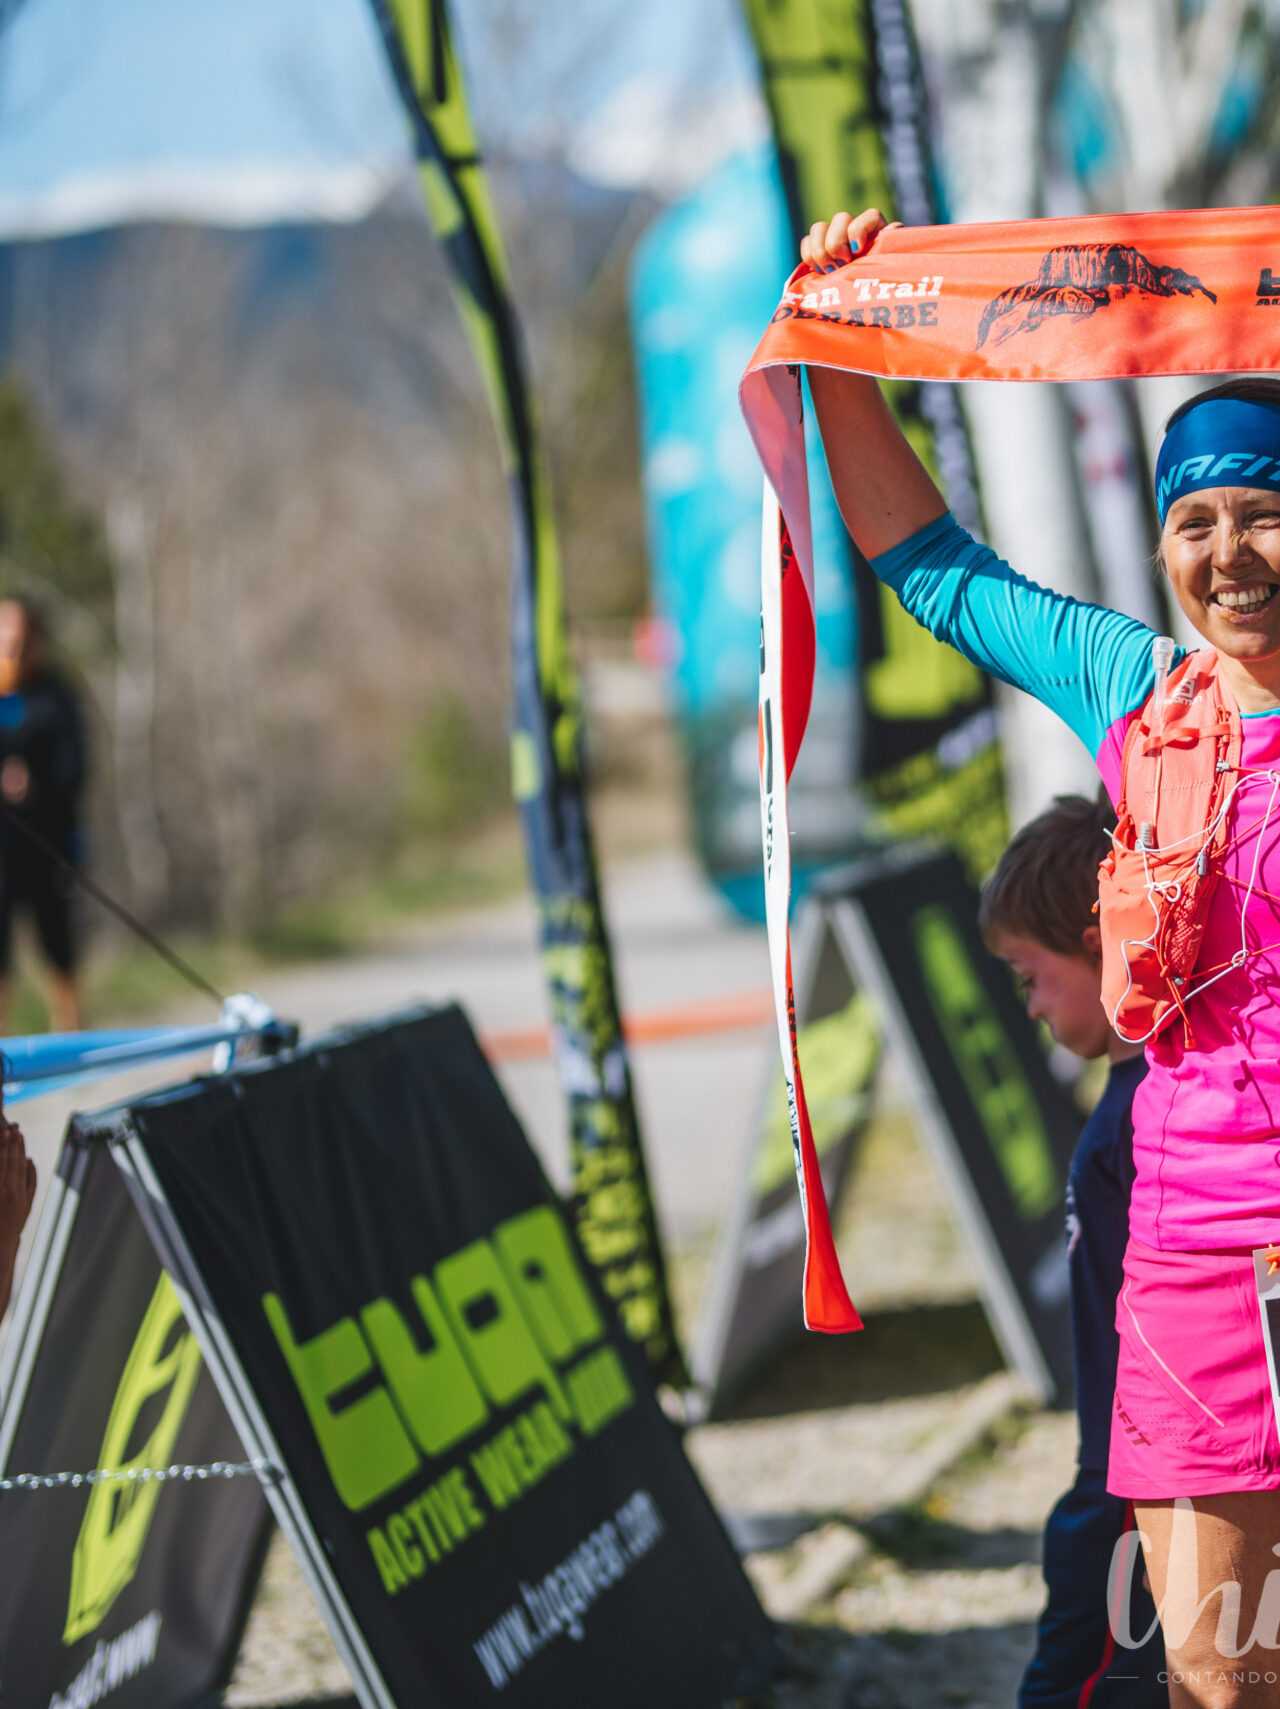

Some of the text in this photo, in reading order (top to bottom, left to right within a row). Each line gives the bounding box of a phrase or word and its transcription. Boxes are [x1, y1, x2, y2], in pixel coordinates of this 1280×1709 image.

[782, 275, 944, 309] ran Trail
[771, 302, 939, 329] OBRARBE
[366, 1466, 486, 1595] ACTIVE
